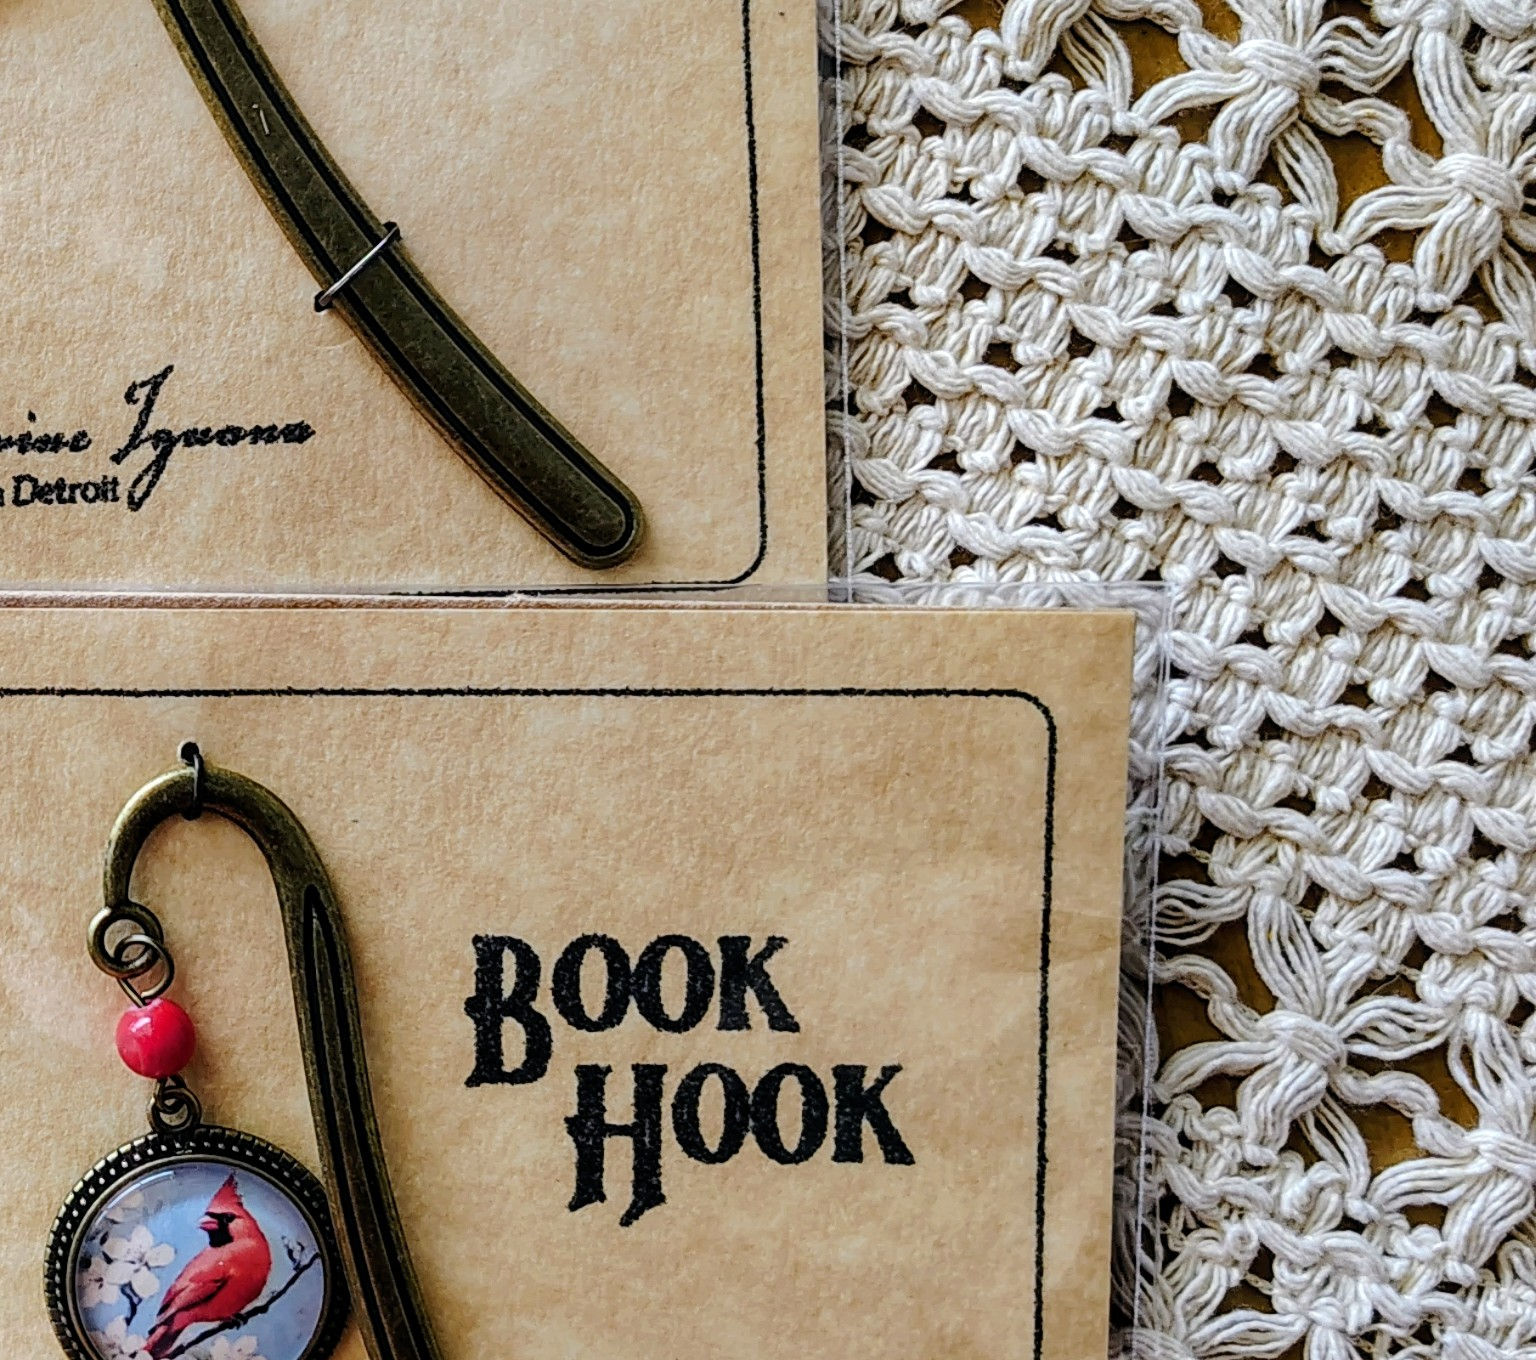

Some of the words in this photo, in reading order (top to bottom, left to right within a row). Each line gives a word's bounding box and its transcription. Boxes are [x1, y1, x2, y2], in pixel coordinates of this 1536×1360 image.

[11, 474, 121, 508] Detroit
[110, 364, 315, 512] Iguana
[464, 933, 800, 1087] BOOK
[564, 1061, 916, 1227] HOOK
